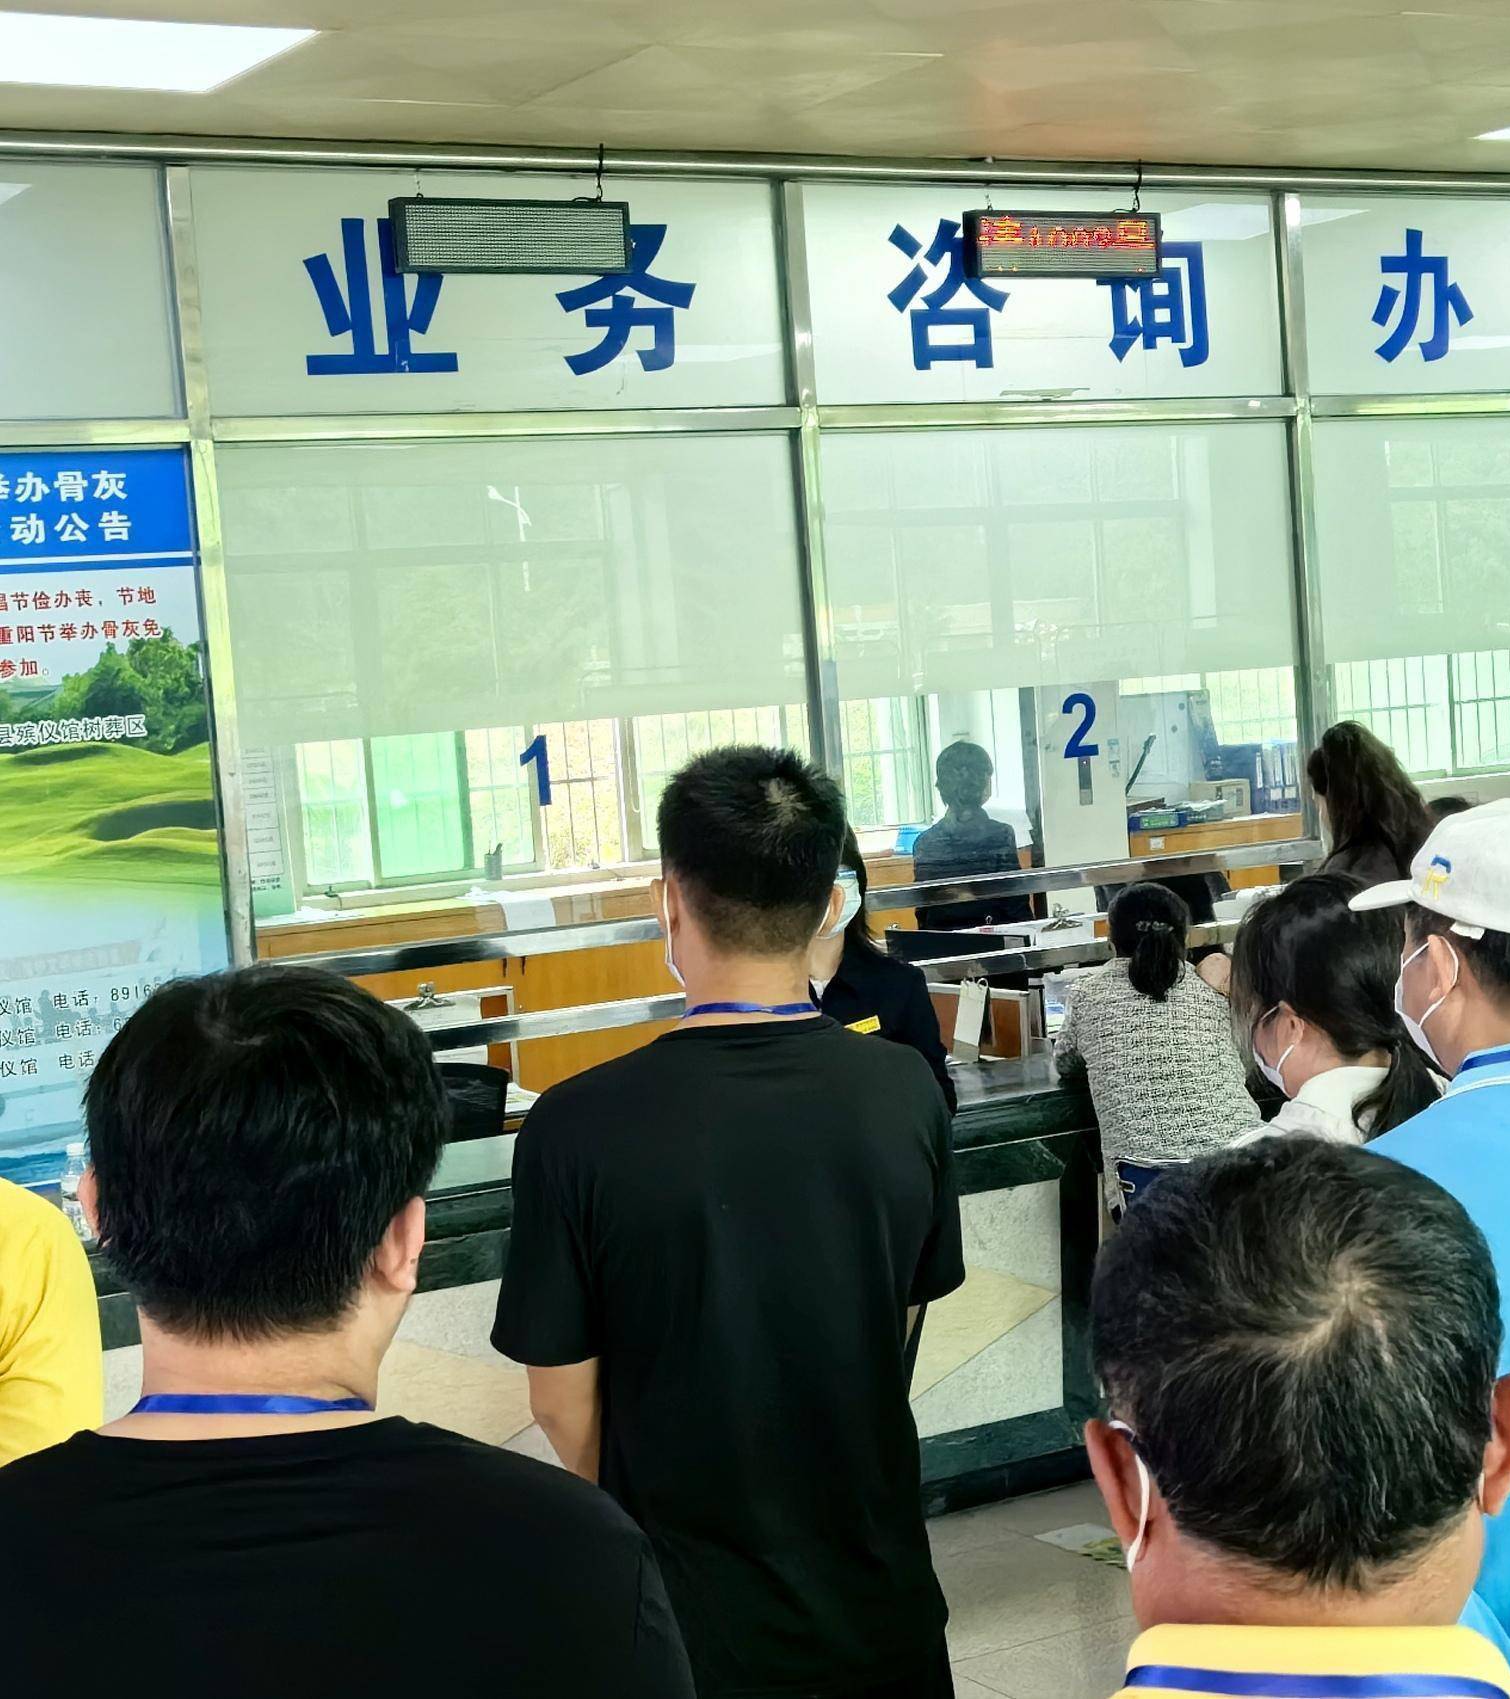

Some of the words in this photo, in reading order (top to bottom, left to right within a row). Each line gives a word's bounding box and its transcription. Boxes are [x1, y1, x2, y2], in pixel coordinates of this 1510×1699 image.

[1061, 692, 1100, 760] 2
[519, 734, 552, 806] 1
[0, 1058, 38, 1078] 仪馆
